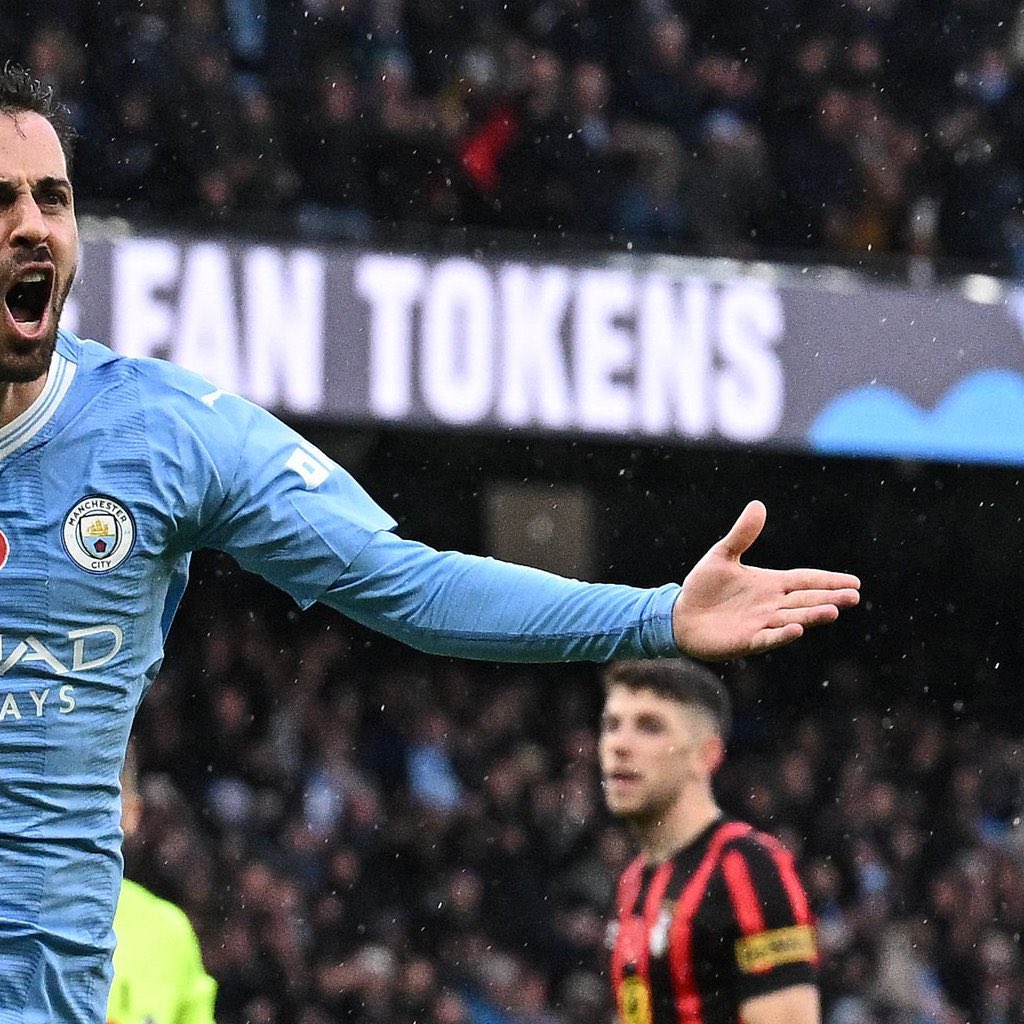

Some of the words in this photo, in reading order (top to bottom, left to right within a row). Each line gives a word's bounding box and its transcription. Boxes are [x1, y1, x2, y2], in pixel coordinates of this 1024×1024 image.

[112, 238, 326, 412] FAN
[356, 255, 784, 442] TOKENS
[68, 500, 127, 526] MANCHESTER
[91, 560, 112, 570] CITY
